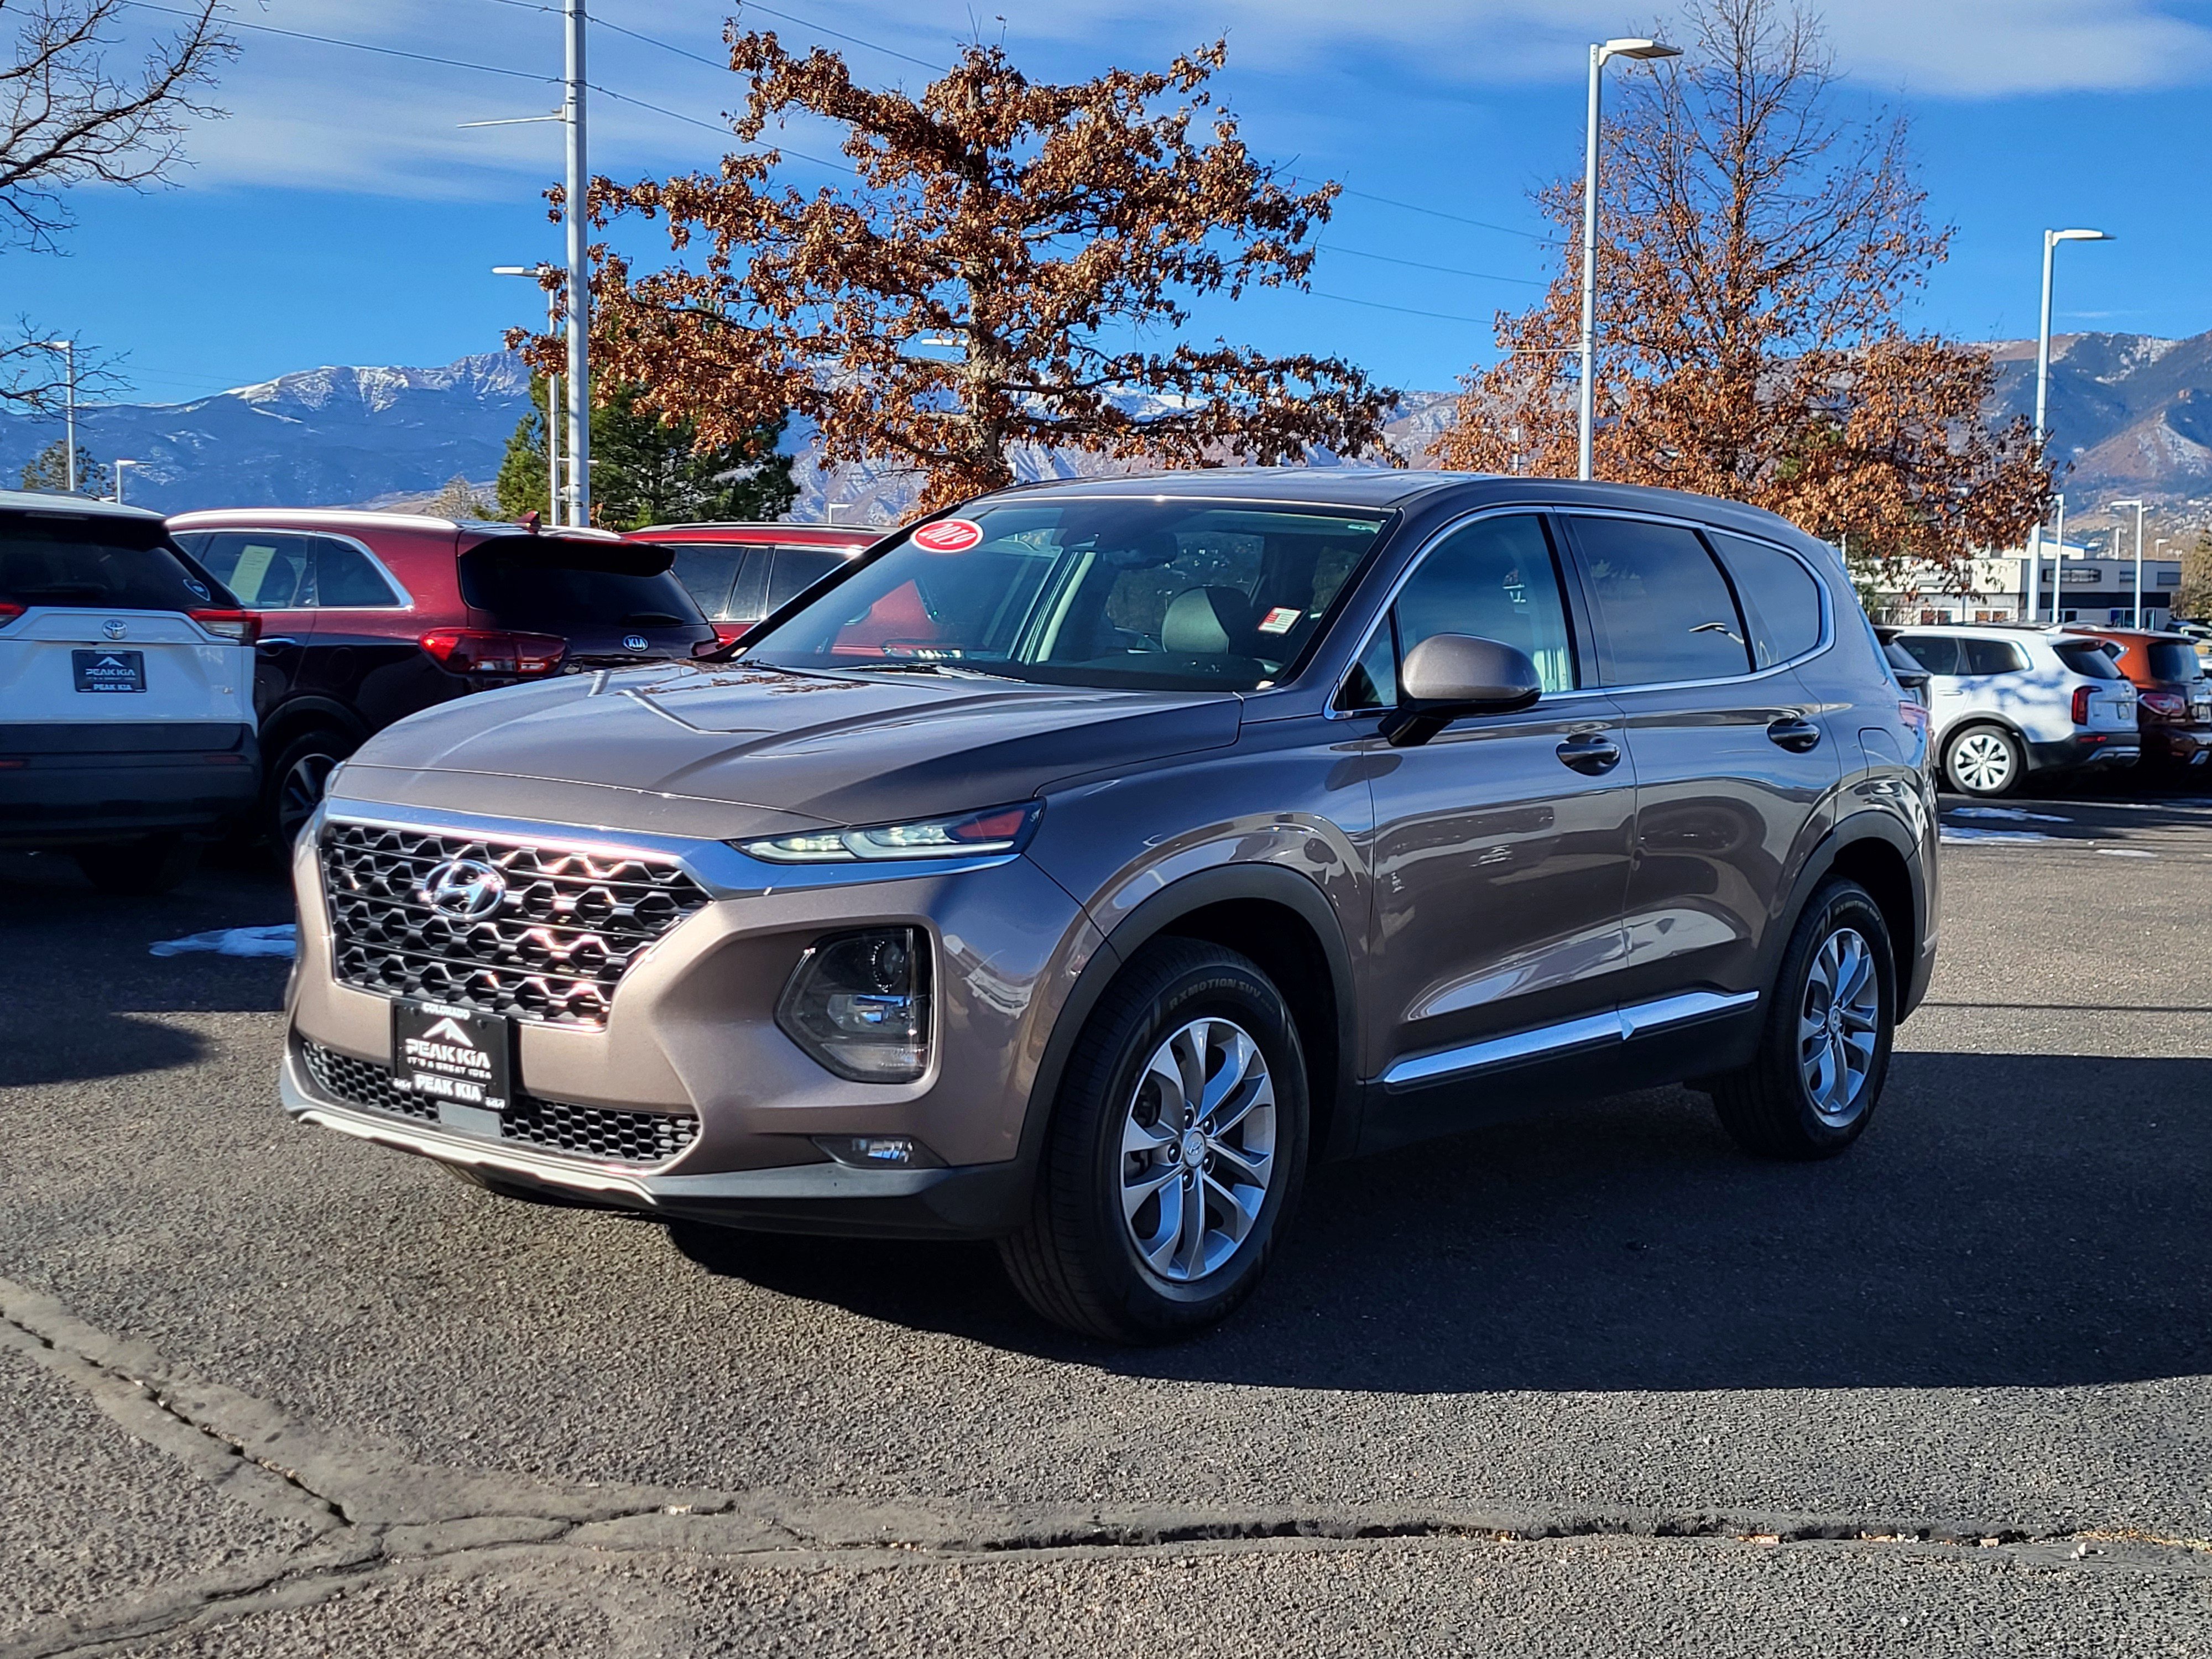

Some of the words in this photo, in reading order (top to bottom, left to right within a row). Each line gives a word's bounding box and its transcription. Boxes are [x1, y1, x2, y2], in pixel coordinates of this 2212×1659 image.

[918, 523, 977, 545] 2019
[628, 638, 646, 648] KIA
[1238, 980, 1261, 998] SUV
[405, 1039, 456, 1063] PEAK
[414, 1074, 453, 1096] PEAK
[455, 1082, 481, 1102] KIA
